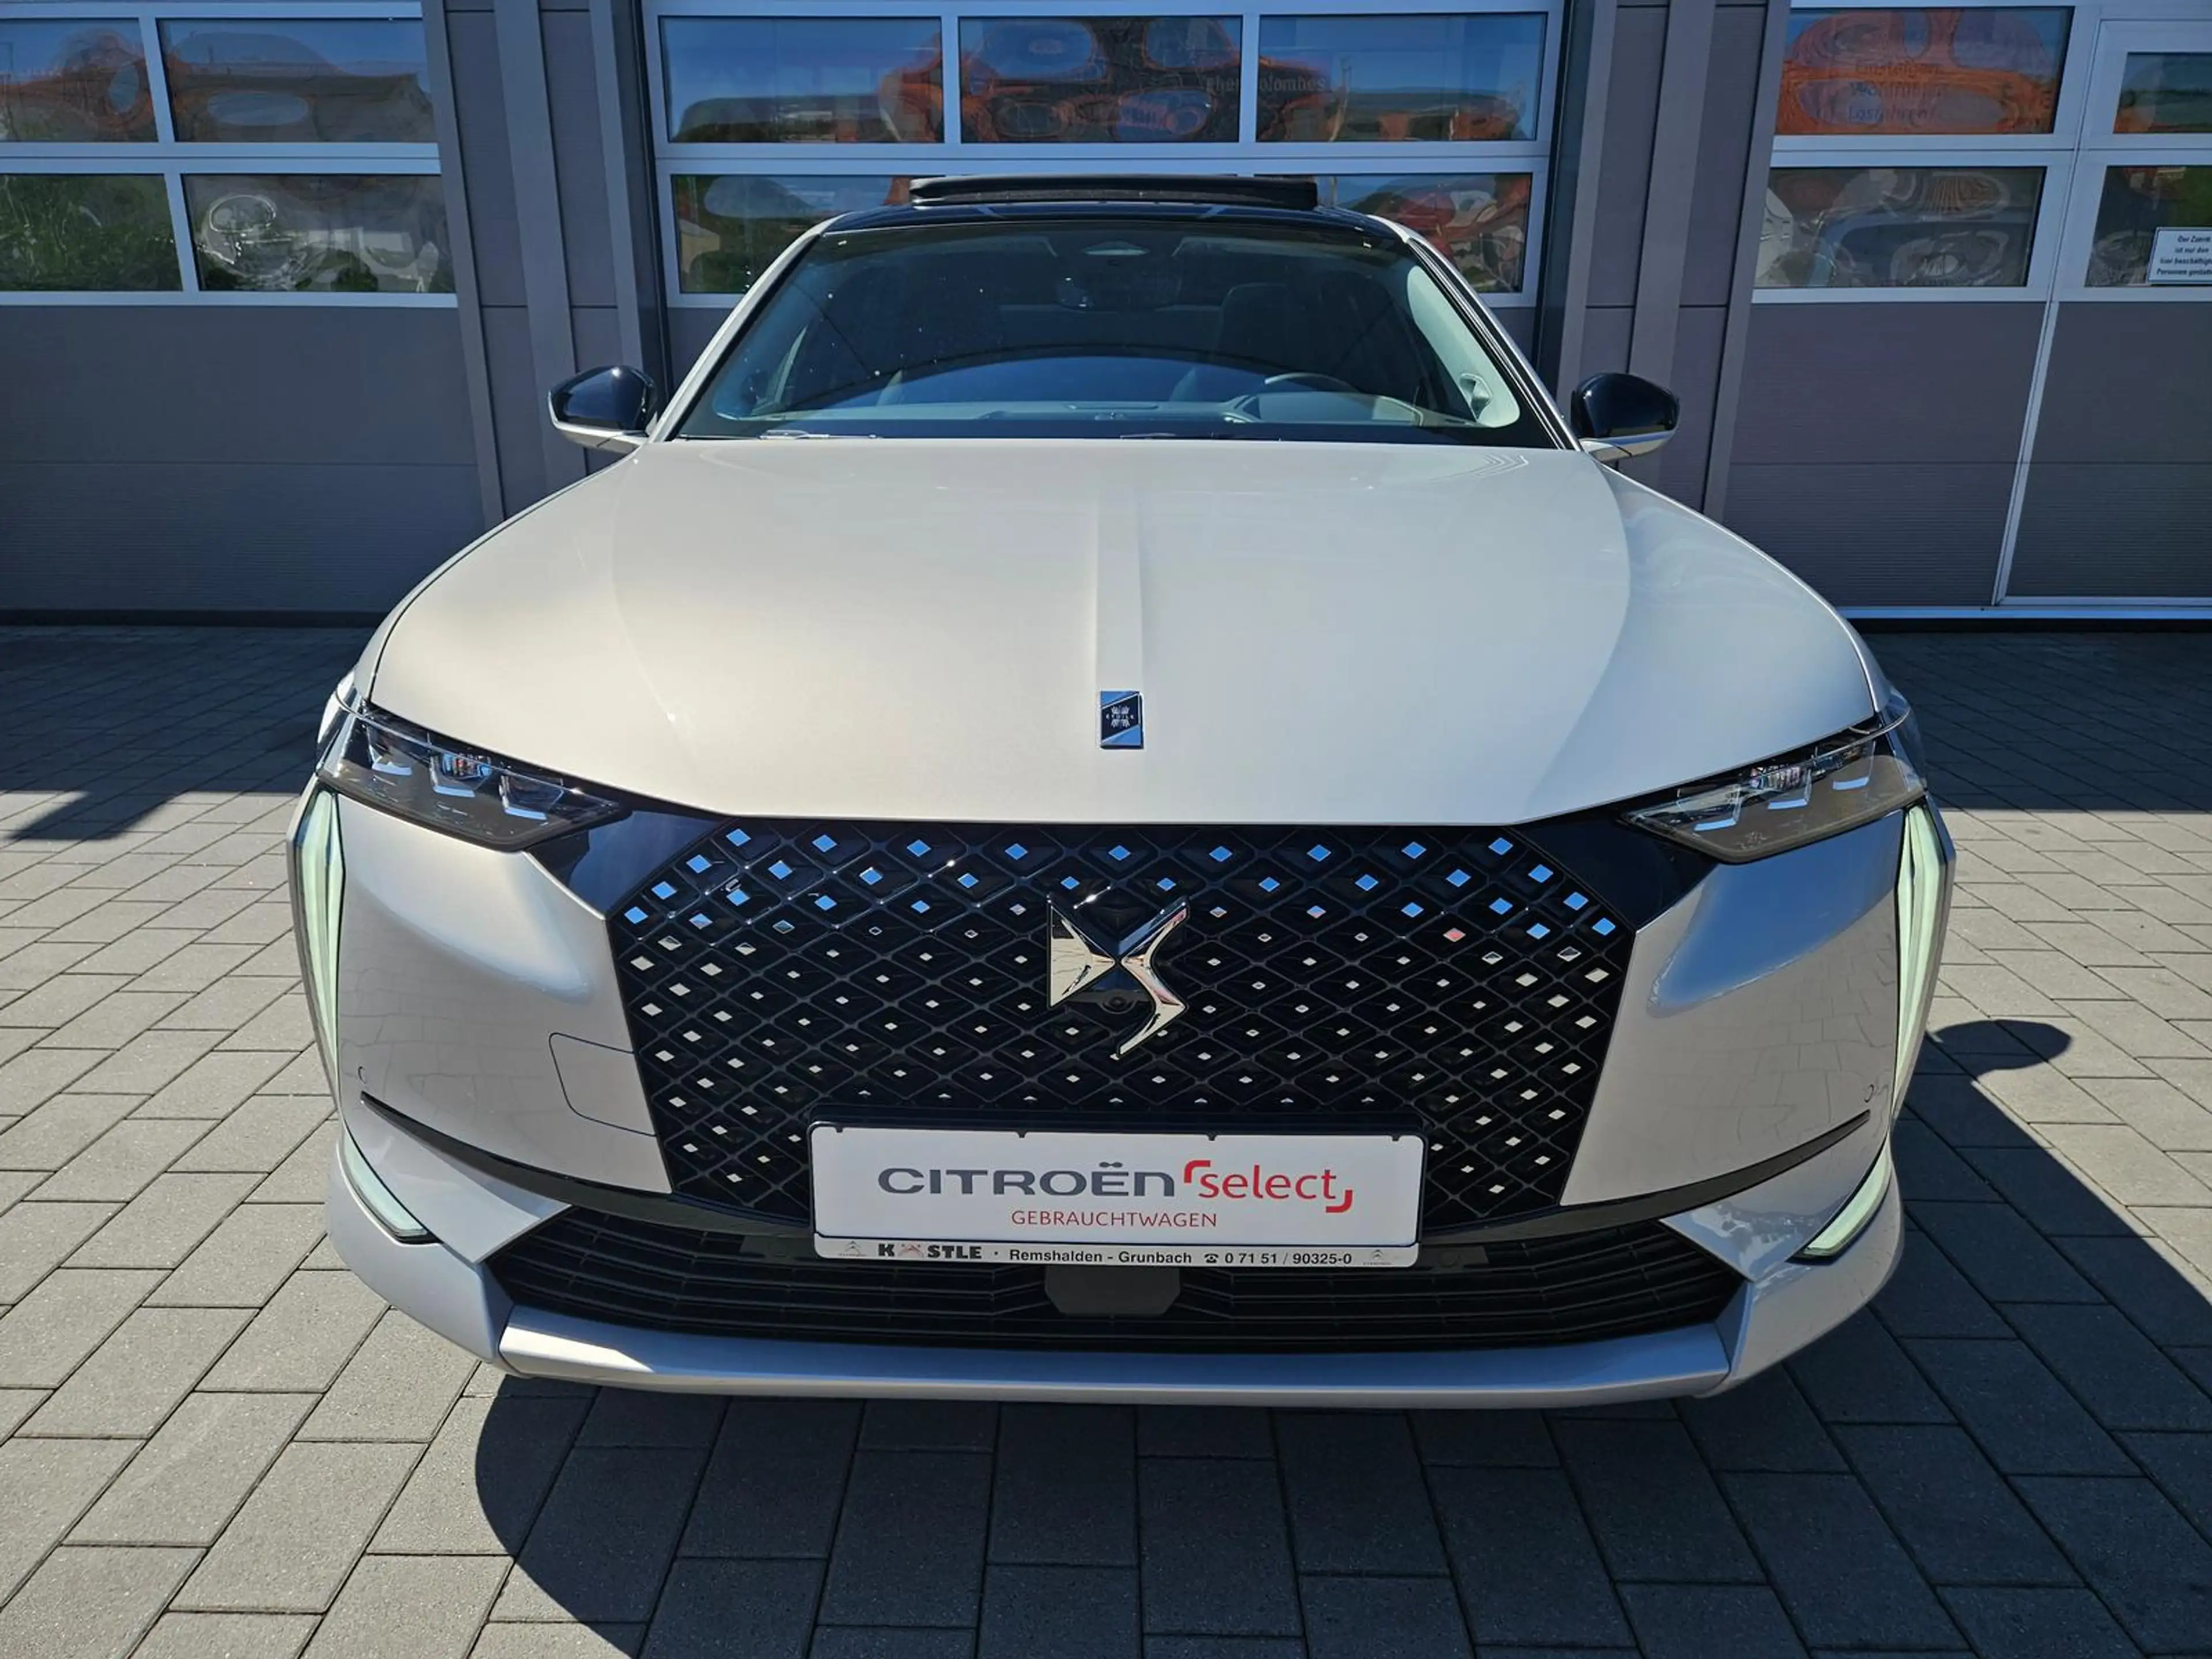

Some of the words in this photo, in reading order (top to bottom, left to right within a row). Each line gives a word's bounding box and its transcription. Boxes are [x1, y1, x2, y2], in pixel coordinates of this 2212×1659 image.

[1012, 1210, 1217, 1228] GEBRAUCHTWAGEN
[1009, 1249, 1103, 1262] Remshalden
[1119, 1251, 1192, 1264] Grunbach
[1293, 1253, 1352, 1264] 90325-0
